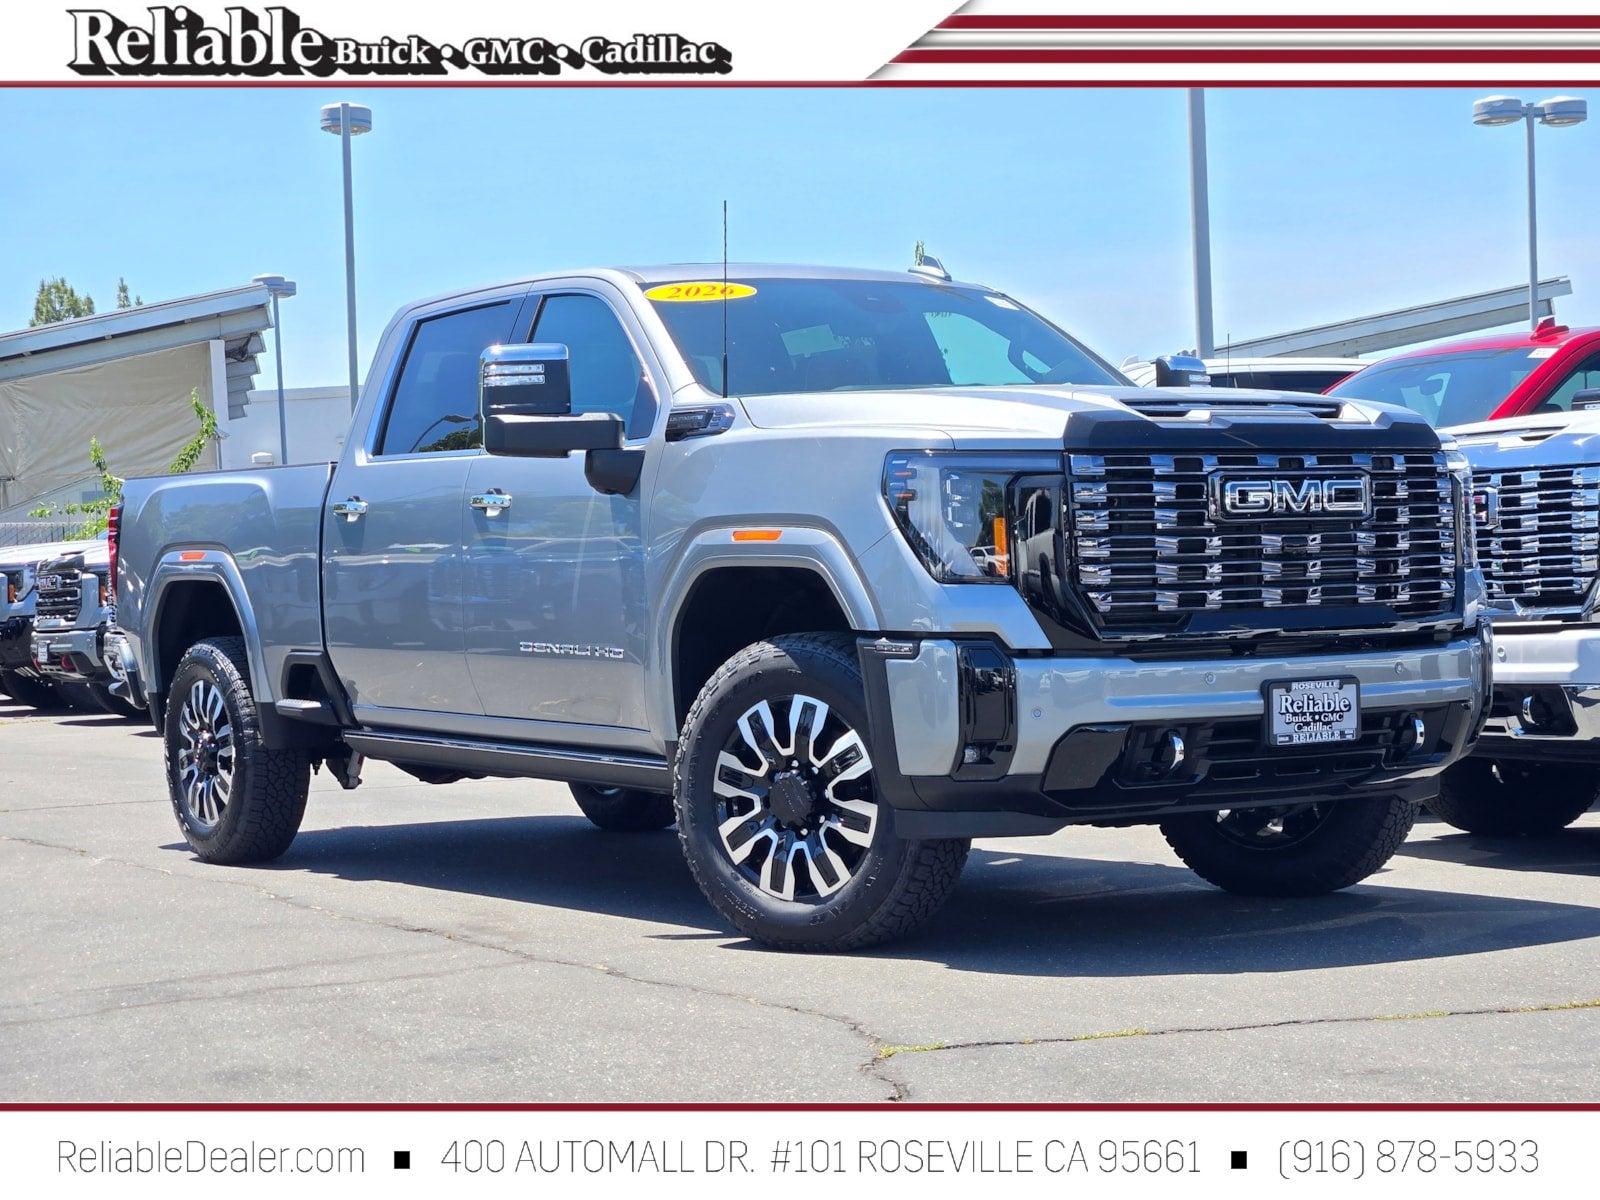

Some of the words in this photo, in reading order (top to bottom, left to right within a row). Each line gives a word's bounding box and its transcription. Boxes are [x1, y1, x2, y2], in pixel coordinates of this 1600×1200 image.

[667, 285, 735, 299] 2026
[1225, 479, 1364, 513] GMC
[519, 641, 591, 656] DENALI
[594, 645, 624, 659] HD
[1291, 680, 1340, 690] ROSEVILLE
[1279, 692, 1351, 715] Reliable
[1285, 713, 1313, 724] Buick
[1320, 712, 1344, 722] GMC
[1294, 722, 1332, 732] Cadillac
[1292, 731, 1341, 743] RELIABLE
